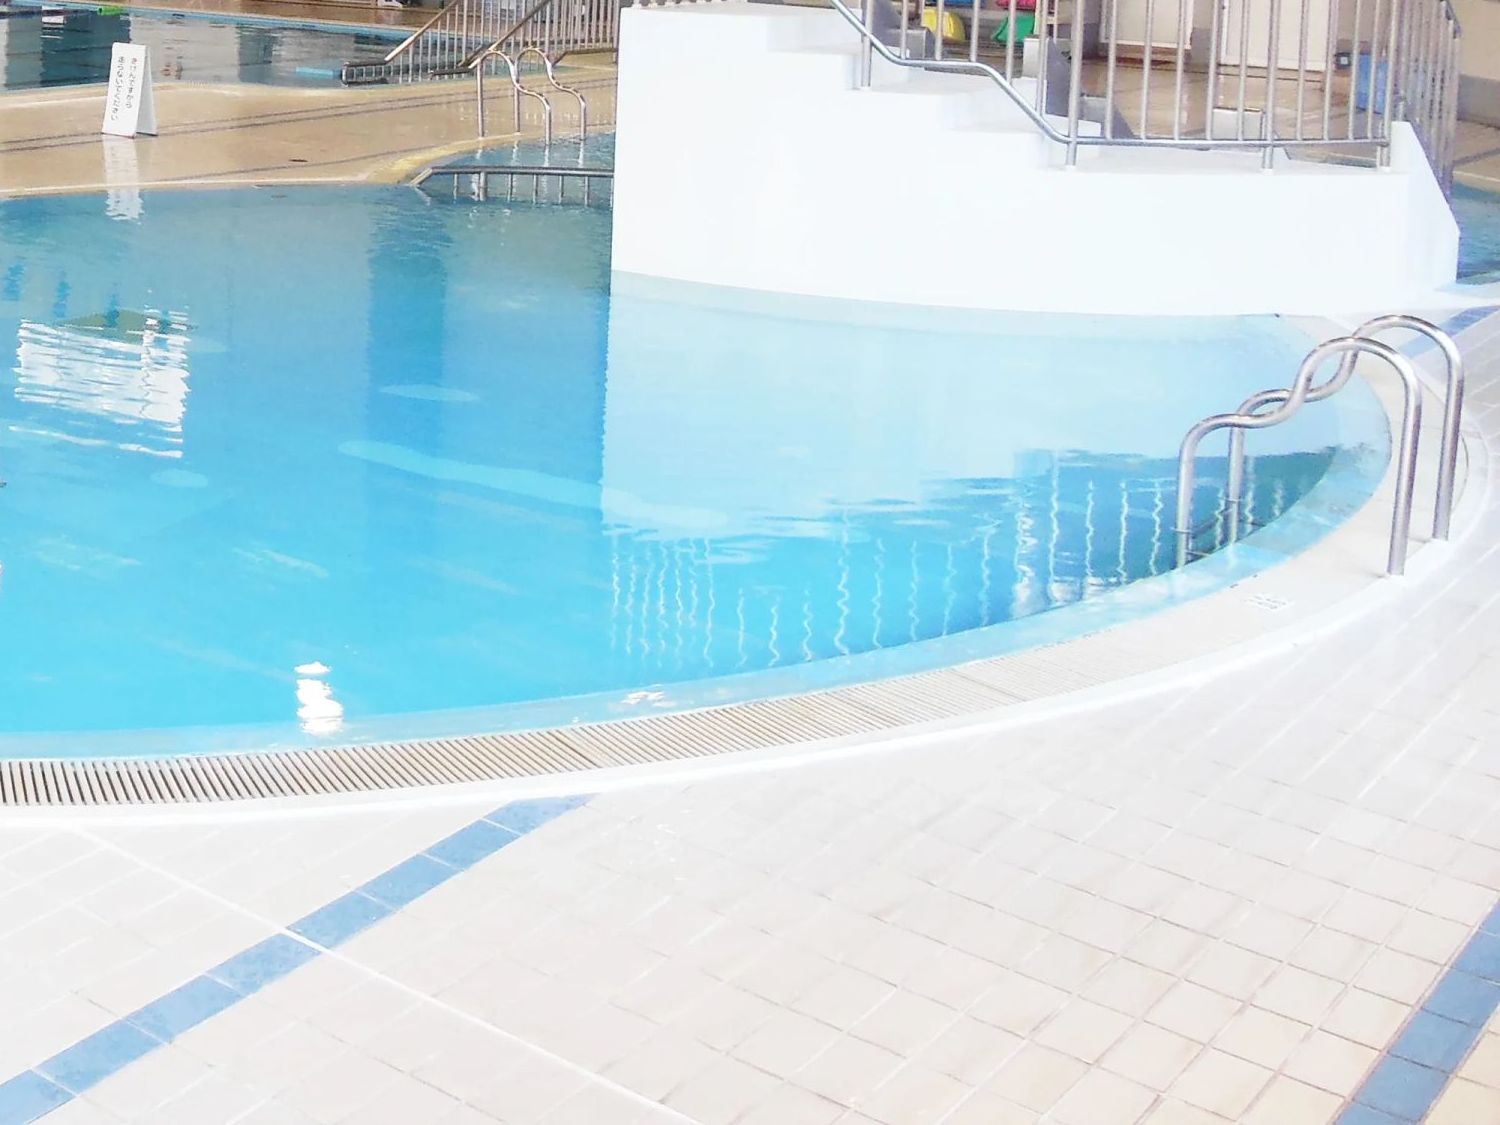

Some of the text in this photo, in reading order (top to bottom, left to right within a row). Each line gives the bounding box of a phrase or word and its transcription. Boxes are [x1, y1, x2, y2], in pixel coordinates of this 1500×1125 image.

[111, 56, 125, 121] 走らないでください
[126, 58, 138, 109] きけんですから
